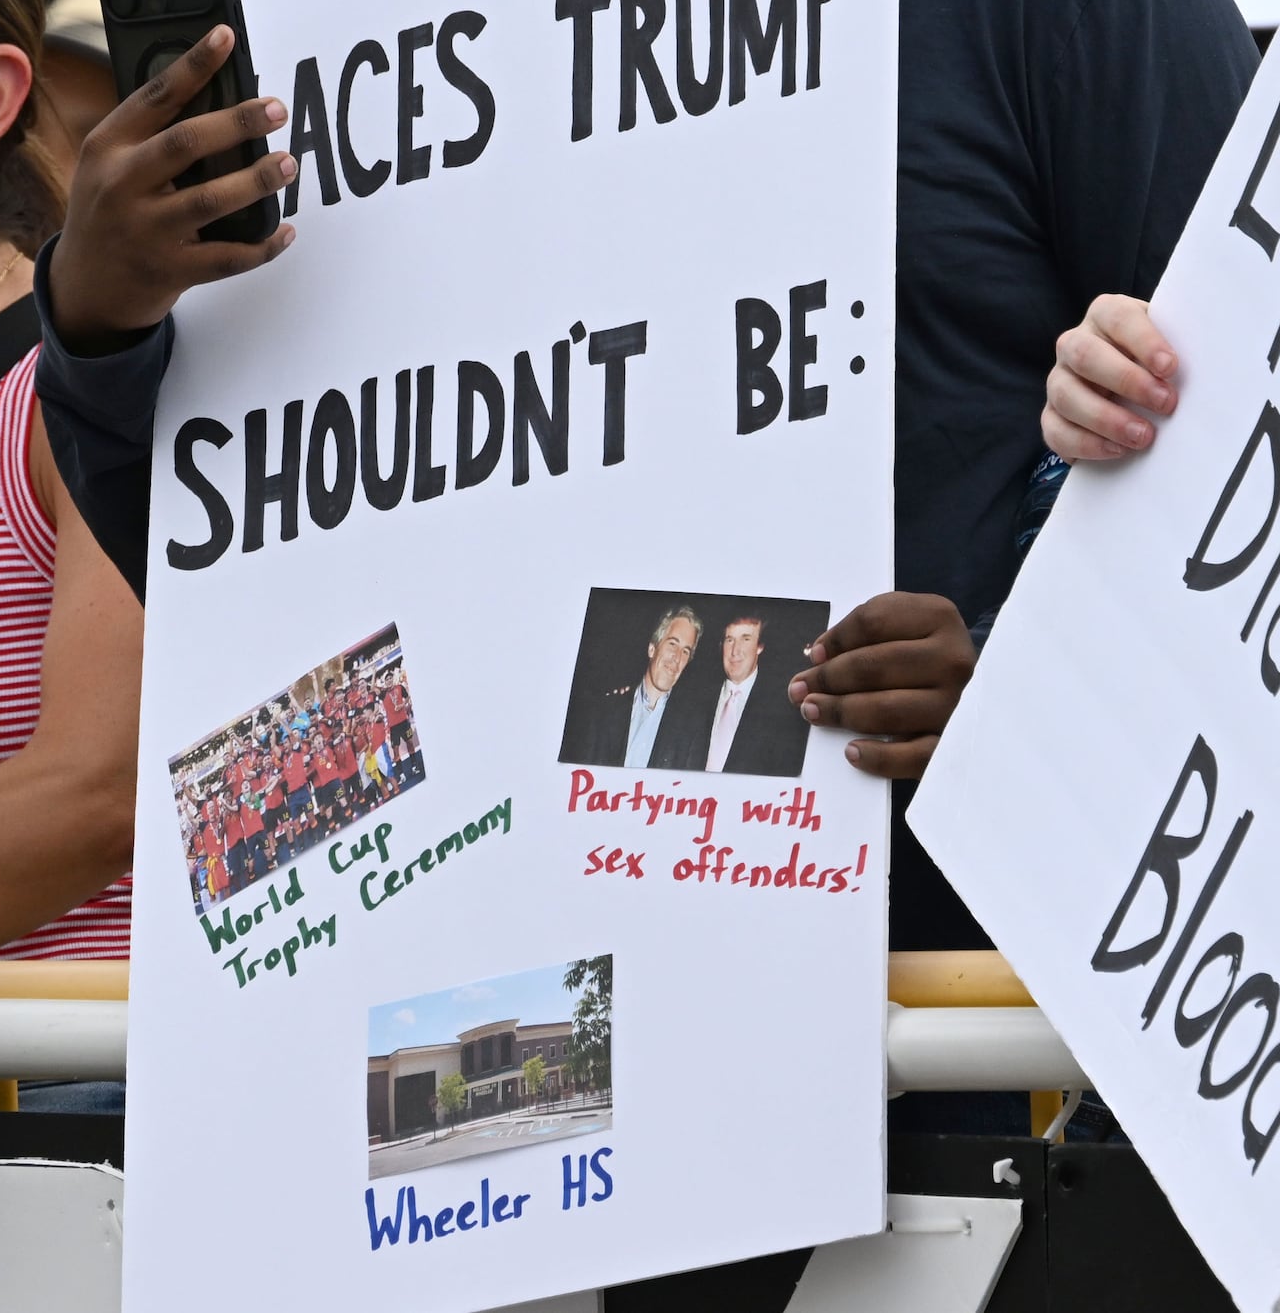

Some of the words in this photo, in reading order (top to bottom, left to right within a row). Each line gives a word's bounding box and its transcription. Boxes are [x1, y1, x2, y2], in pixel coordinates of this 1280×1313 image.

[257, 11, 496, 218] ACES
[167, 320, 648, 571] SHOULDN'T
[568, 769, 718, 843] Partying
[742, 786, 823, 833] with
[584, 847, 646, 879] sex
[673, 841, 868, 894] offenders!
[197, 869, 304, 954] World
[328, 821, 392, 875] Cup
[222, 911, 338, 989] Trophy
[360, 797, 513, 912] Ceremony
[365, 1178, 530, 1251] Wheeler
[561, 1146, 614, 1211] HS
